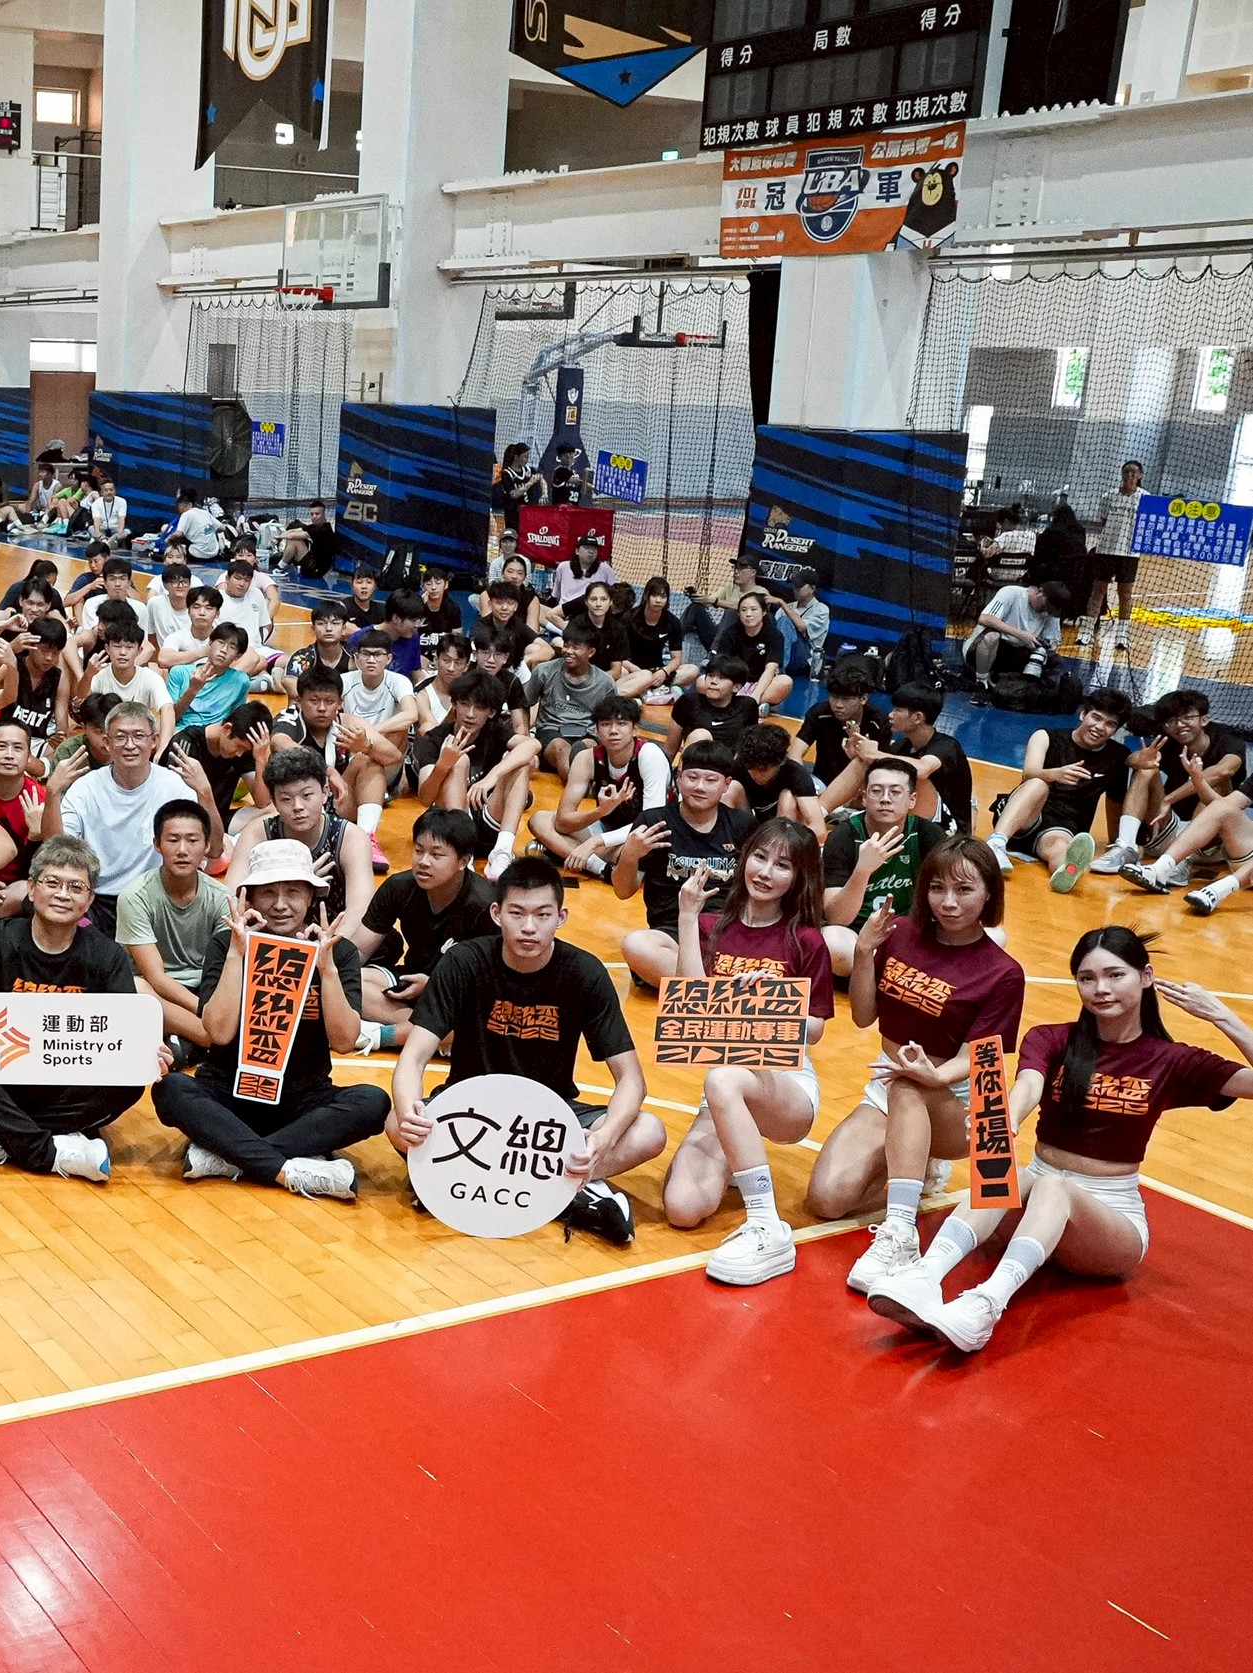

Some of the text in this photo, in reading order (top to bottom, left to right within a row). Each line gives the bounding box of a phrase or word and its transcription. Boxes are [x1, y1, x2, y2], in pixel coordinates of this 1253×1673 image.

[919, 4, 961, 31] 得分
[813, 26, 852, 51] 局數
[720, 45, 752, 68] 得分
[703, 90, 968, 146] 犯規次數 球員犯規次數 犯規次數
[764, 170, 902, 211] 冠 軍
[803, 168, 861, 195] UBA
[737, 187, 758, 200] 101
[527, 532, 560, 546] SPALDING
[761, 533, 810, 553] RANGERS
[775, 528, 816, 546] DESERT
[12, 705, 51, 728] HEAT
[42, 1014, 109, 1034] 運動部
[660, 1018, 802, 1042] 全民運動賽事
[42, 1038, 123, 1053] Ministry of
[656, 1044, 801, 1067] 2025
[42, 1053, 93, 1067] Sports
[432, 1107, 568, 1180] 文總
[449, 1182, 531, 1208] GACC
